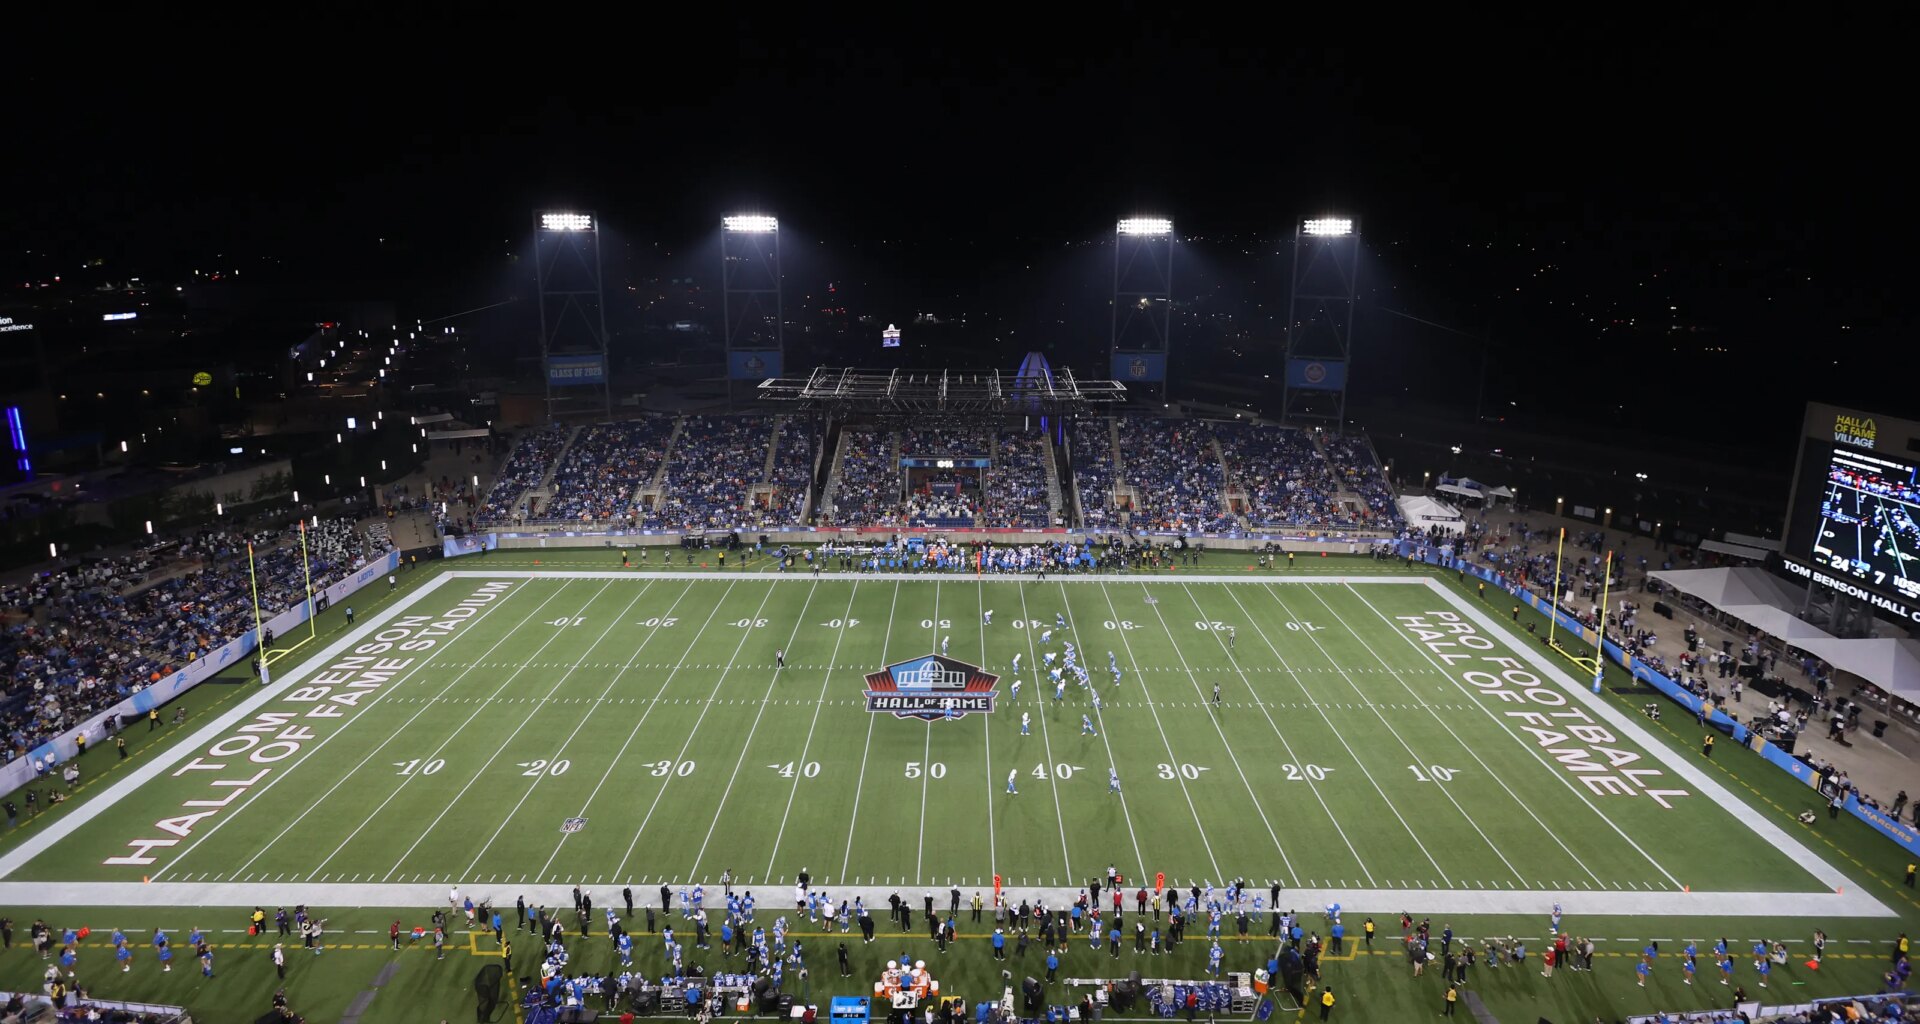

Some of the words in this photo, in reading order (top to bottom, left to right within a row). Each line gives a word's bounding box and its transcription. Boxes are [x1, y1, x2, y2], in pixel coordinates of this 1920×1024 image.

[550, 368, 573, 378] CLASS
[1836, 415, 1861, 428] HALL
[1834, 424, 1848, 433] OF
[1850, 427, 1876, 440] FAME
[1834, 432, 1874, 449] VILLAGE
[1830, 555, 1849, 572] 24
[1874, 570, 1886, 585] 7
[1783, 560, 1812, 578] TOM
[1812, 571, 1868, 601] BENSON
[1871, 594, 1908, 618] HALL
[552, 616, 587, 627] 10
[644, 616, 679, 628] 20
[736, 617, 769, 629] 30
[828, 617, 861, 629] 40
[920, 618, 952, 630] 50
[1012, 620, 1042, 630] 40
[1103, 620, 1133, 630] 30
[1195, 621, 1229, 631] 20
[1285, 621, 1318, 632] 10
[172, 712, 298, 777] TOM
[285, 615, 434, 702] BENSON
[874, 697, 925, 709] HALL
[937, 697, 988, 709] FAME
[1395, 616, 1472, 666] HALL
[1462, 670, 1527, 704] OF
[1504, 711, 1639, 797] FAME
[1425, 611, 1495, 651] PRO
[1481, 656, 1690, 809] FOOTBALL
[102, 768, 273, 865] HALL
[248, 725, 317, 763] OF
[304, 657, 414, 718] FAME
[398, 581, 514, 651] STADIUM
[396, 759, 446, 776] 10
[521, 759, 571, 777] 20
[651, 760, 696, 777] 30
[778, 761, 821, 778] 40
[904, 762, 947, 779] 50
[1032, 763, 1073, 780] 40
[1157, 763, 1200, 780] 30
[1281, 764, 1325, 780] 20
[1407, 764, 1454, 782] 10
[1857, 805, 1913, 843] CHARGERS
